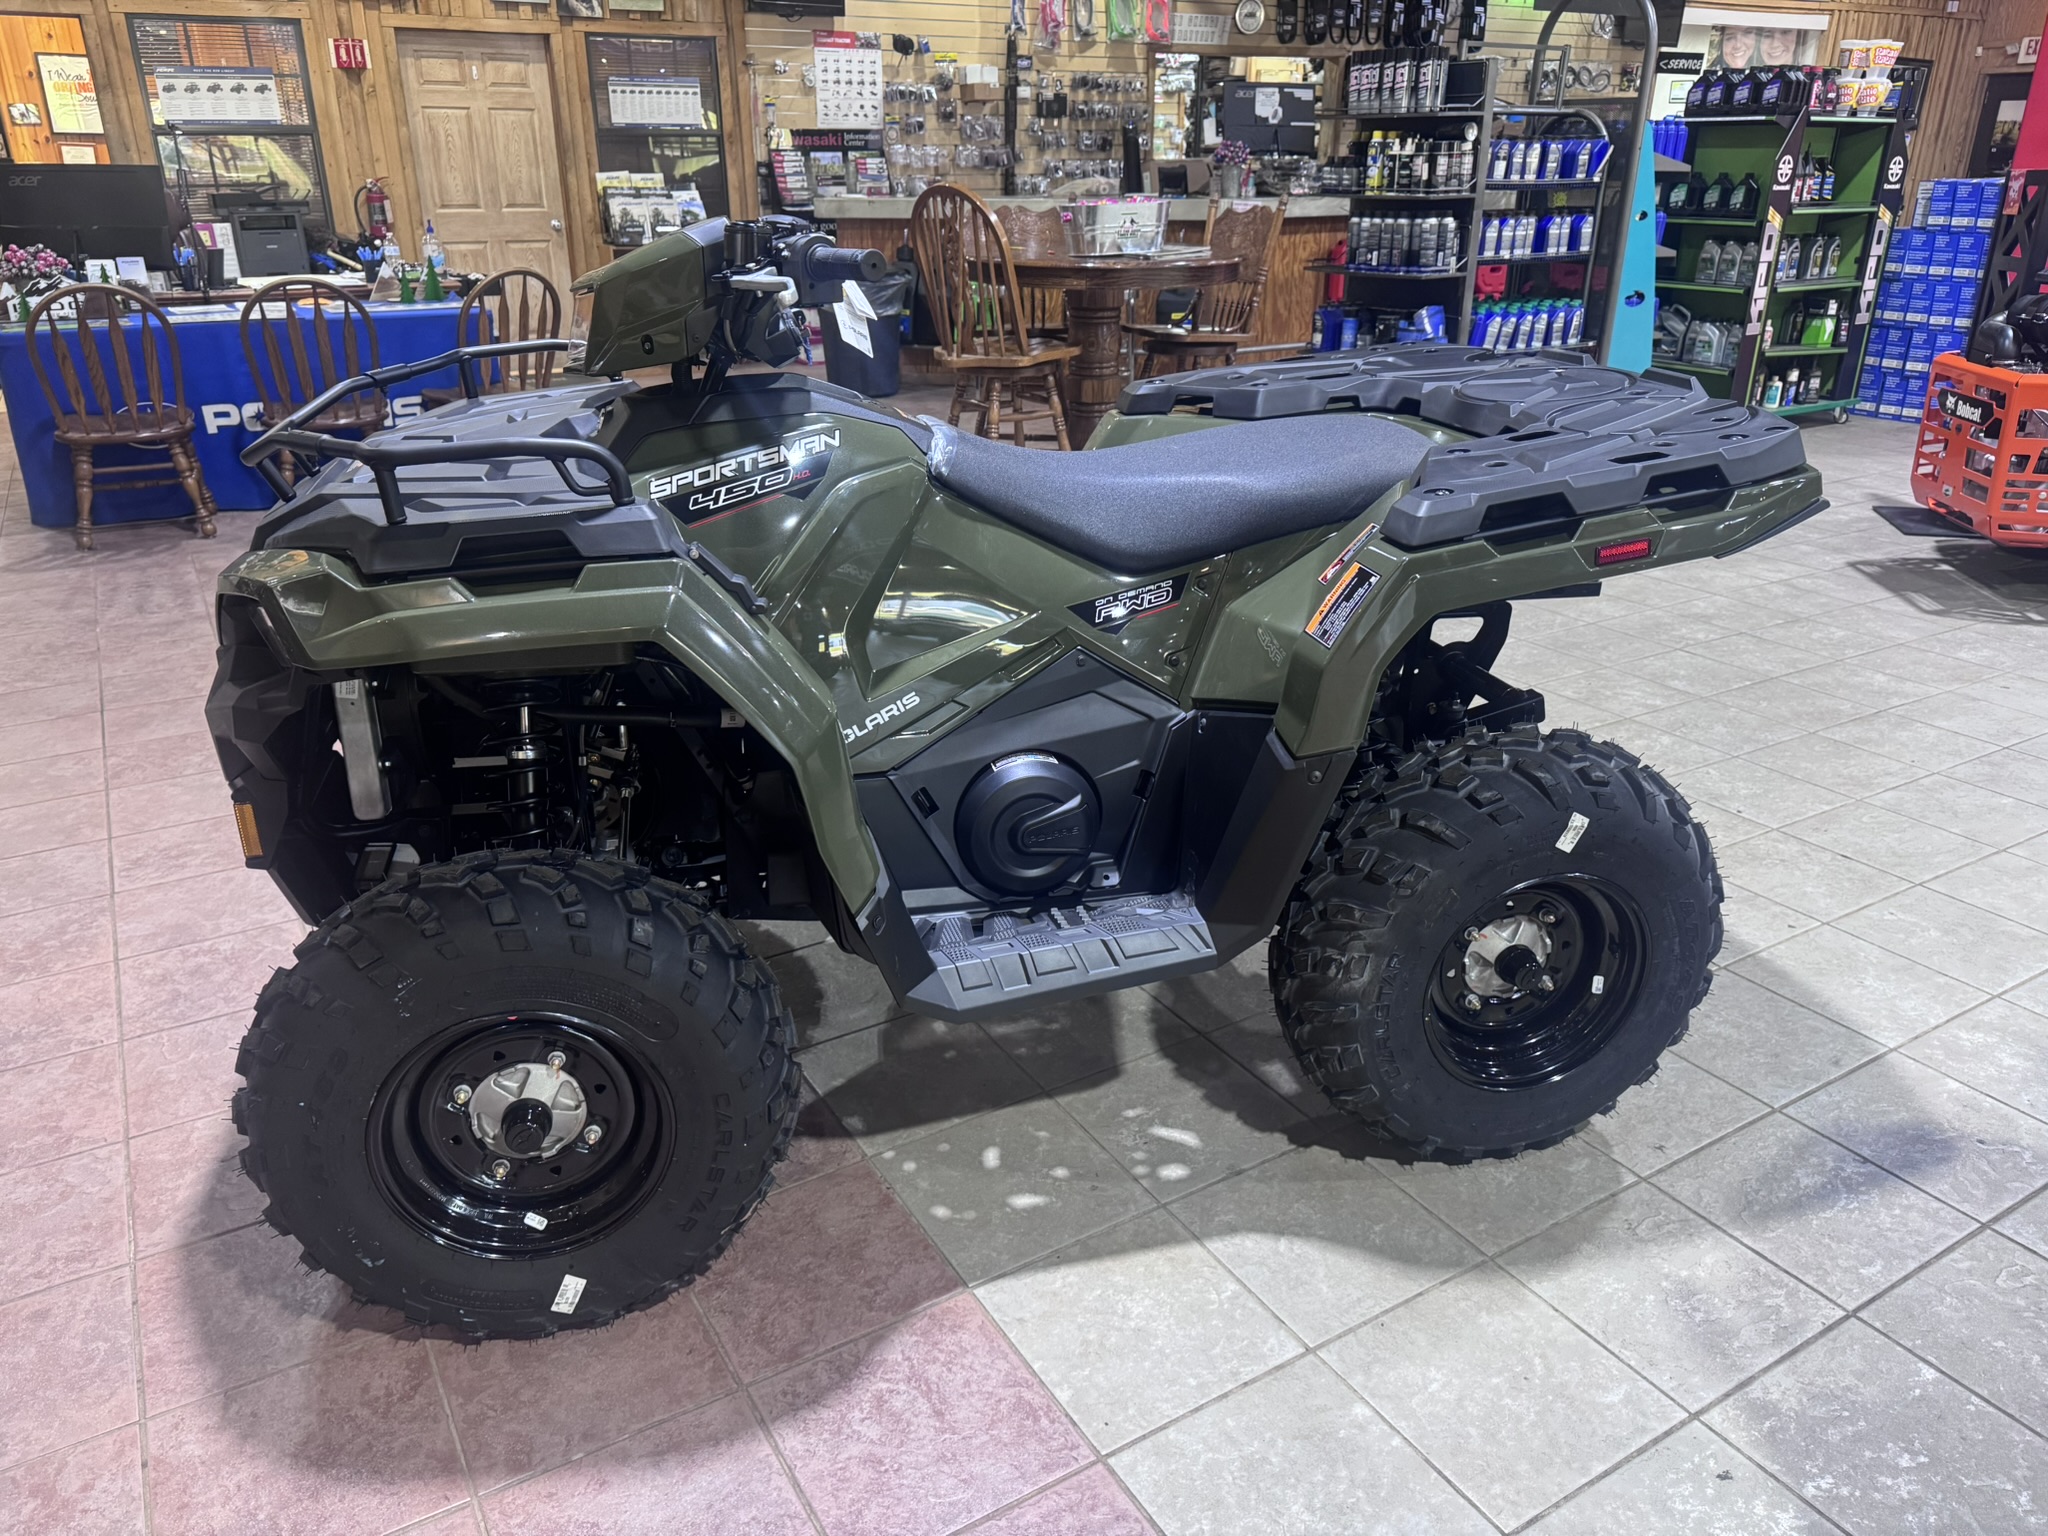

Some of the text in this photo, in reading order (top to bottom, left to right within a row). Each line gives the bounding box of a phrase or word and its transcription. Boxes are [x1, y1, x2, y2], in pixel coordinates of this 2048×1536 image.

[55, 68, 86, 81] Wear
[53, 82, 95, 93] ORANG
[843, 139, 866, 147] Center
[8, 175, 42, 187] acer
[1956, 400, 1982, 423] Bobcat
[650, 429, 841, 499] SPORTSMAN
[689, 467, 811, 510] 450 H.O.
[1095, 579, 1172, 606] ON DEMAND
[1095, 587, 1173, 623] AWD
[1322, 578, 1347, 609] WARNING
[1029, 826, 1080, 844] POLARIS
[678, 1092, 733, 1235] CARLSTAR
